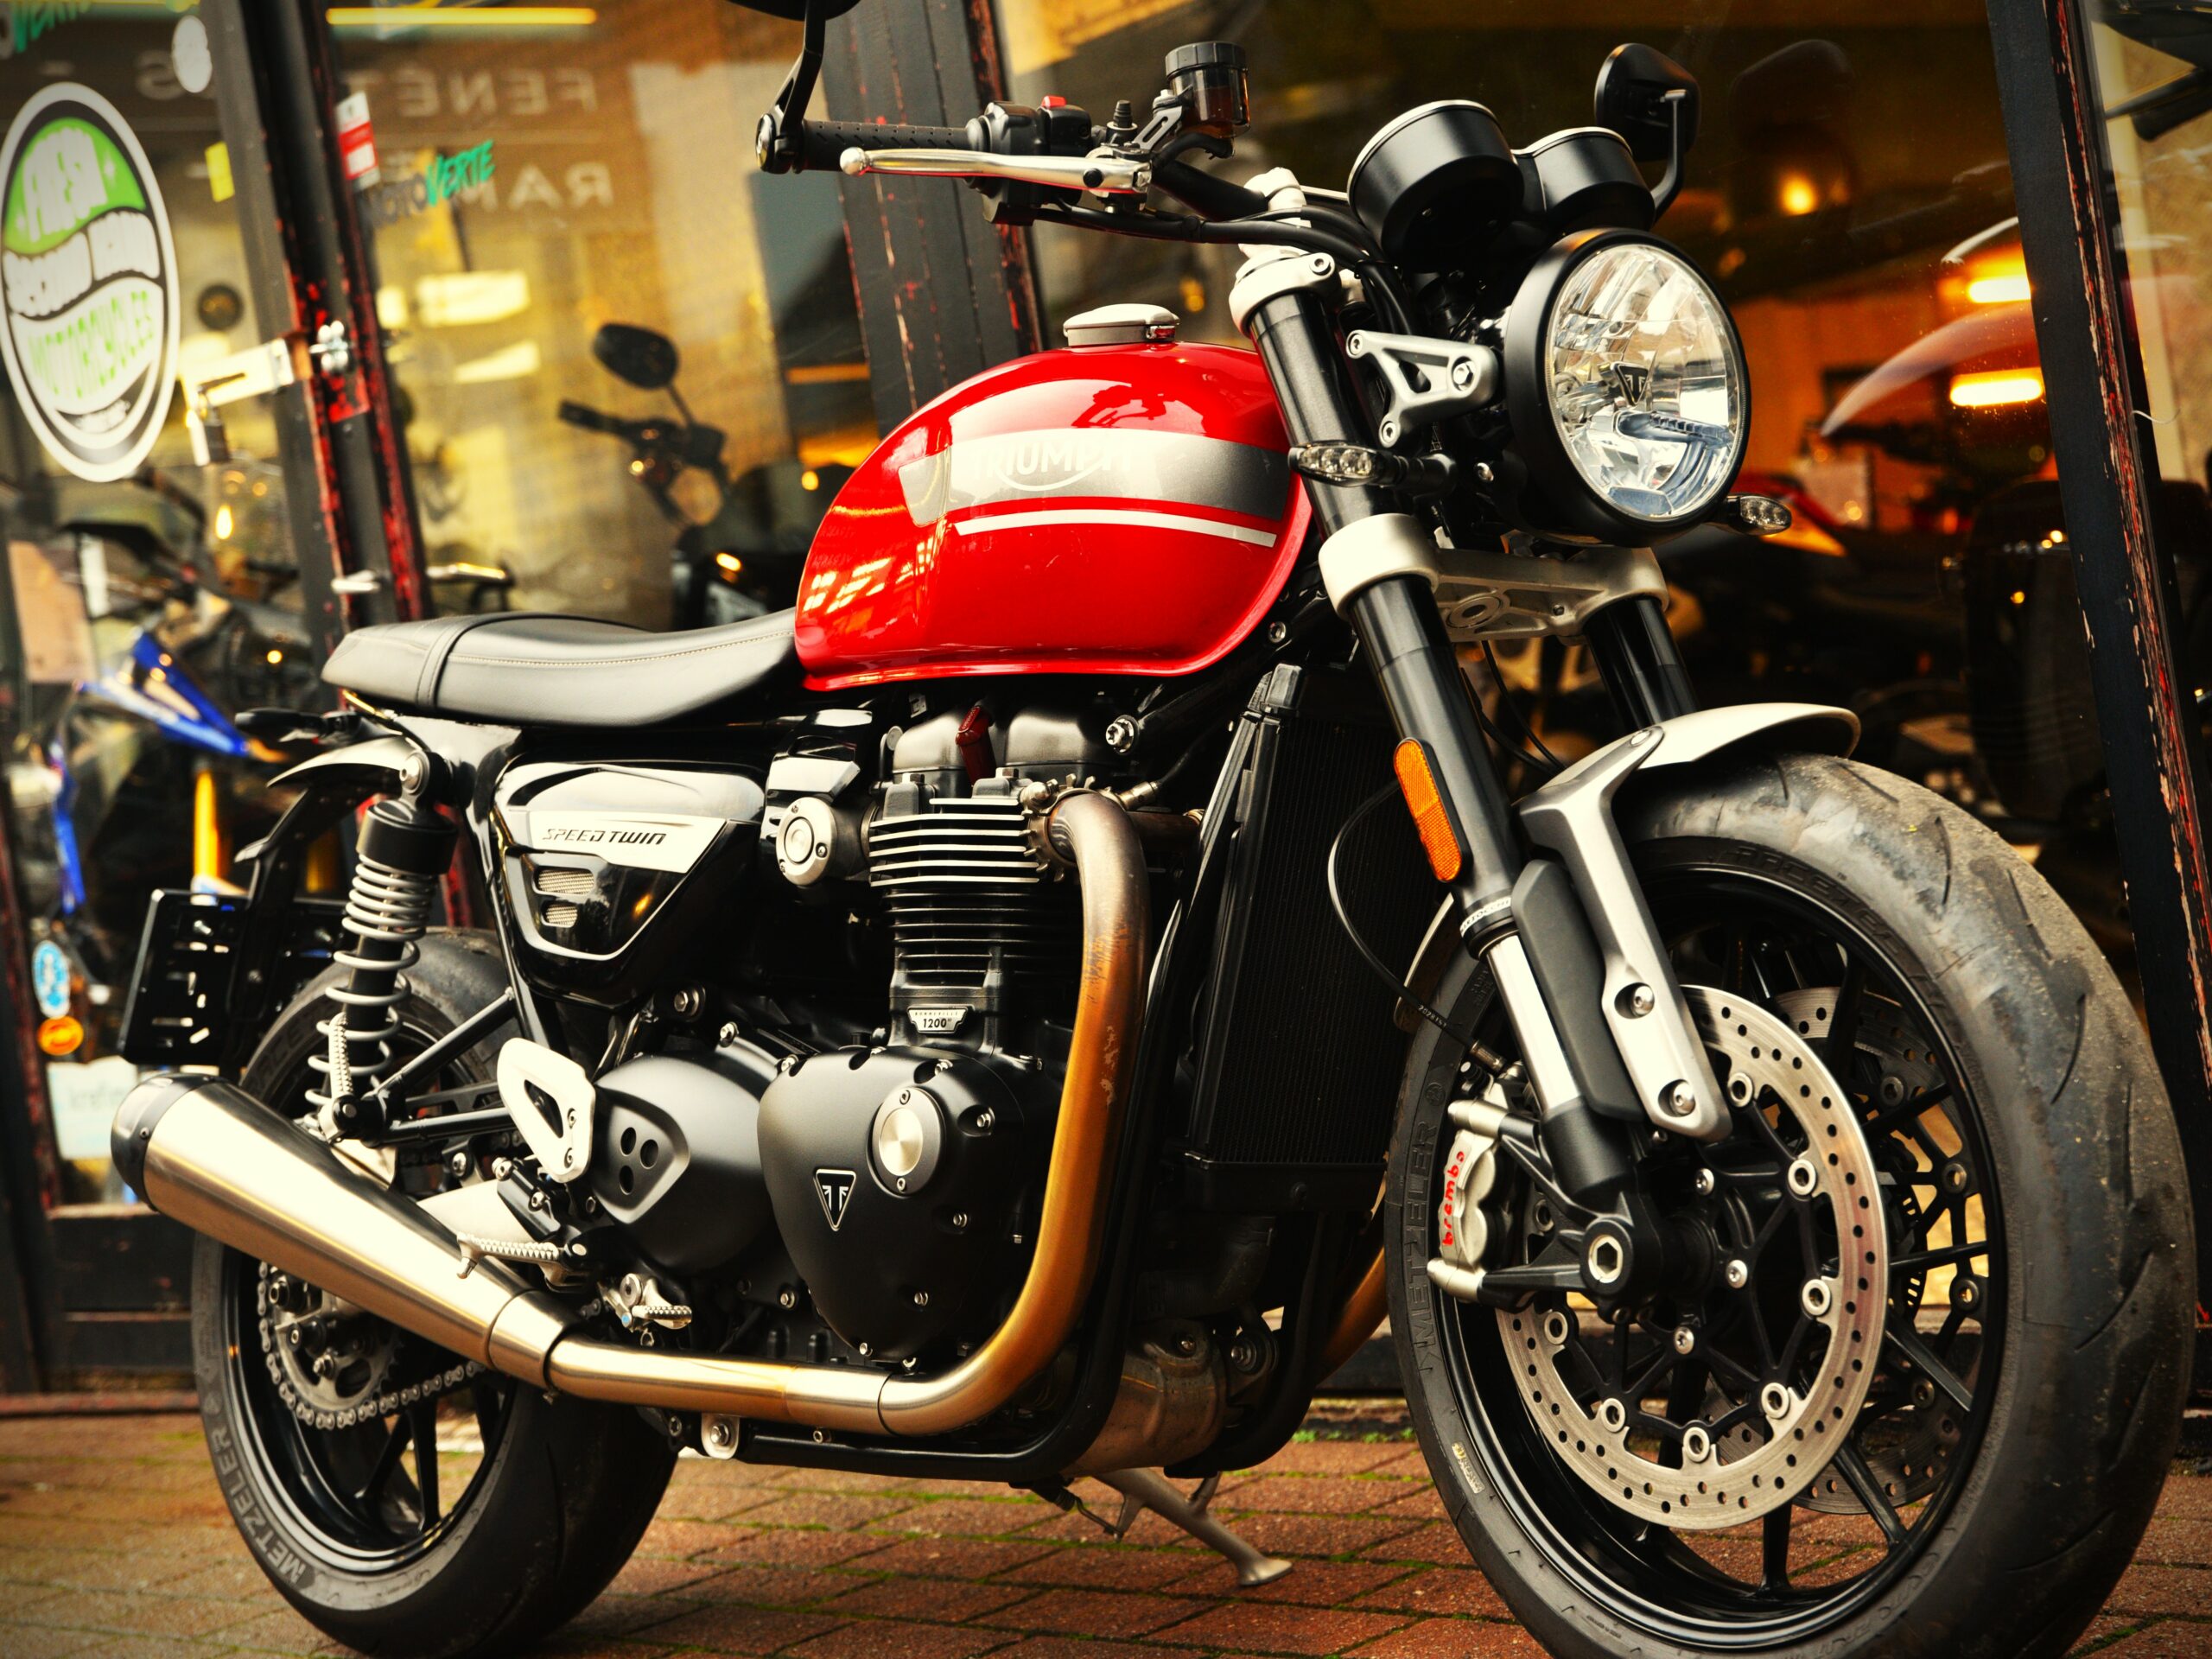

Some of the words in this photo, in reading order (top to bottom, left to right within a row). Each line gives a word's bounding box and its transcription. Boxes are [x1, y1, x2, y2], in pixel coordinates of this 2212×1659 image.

[970, 437, 1134, 491] TRIUMPH
[543, 829, 606, 842] SPEED
[608, 830, 667, 845] TWIN
[923, 1018, 947, 1029] 1200
[1442, 1150, 1465, 1246] brembo
[211, 1425, 308, 1586] METZELER
